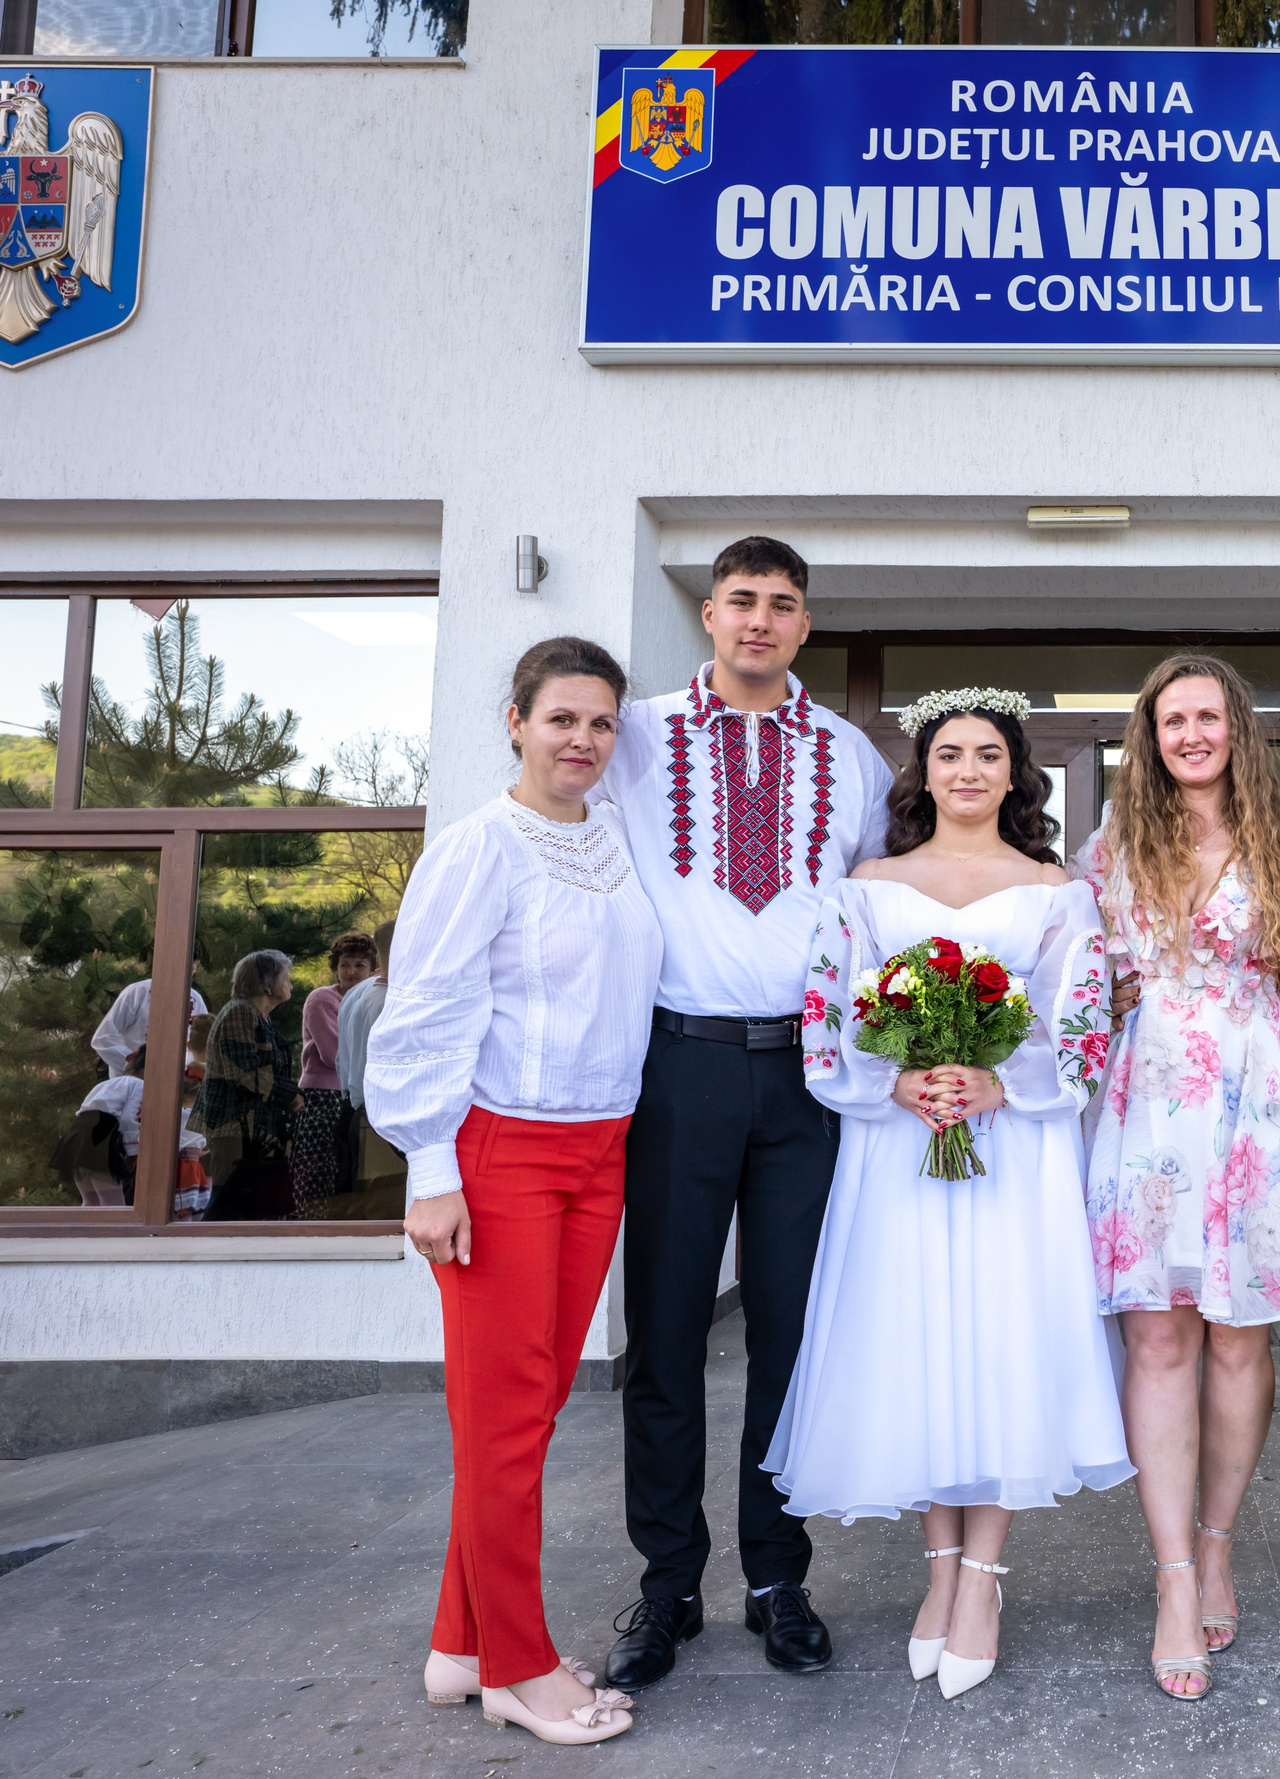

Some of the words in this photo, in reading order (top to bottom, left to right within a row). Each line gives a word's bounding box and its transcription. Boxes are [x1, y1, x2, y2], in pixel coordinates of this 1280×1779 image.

[951, 71, 1194, 114] ROMÂNIA
[862, 127, 1056, 169] JUDEȚUL
[715, 184, 1044, 260] COMUNA
[711, 263, 961, 312] PRIMĂRIA
[975, 293, 992, 301] -
[1007, 274, 1263, 313] CONSILIUL
